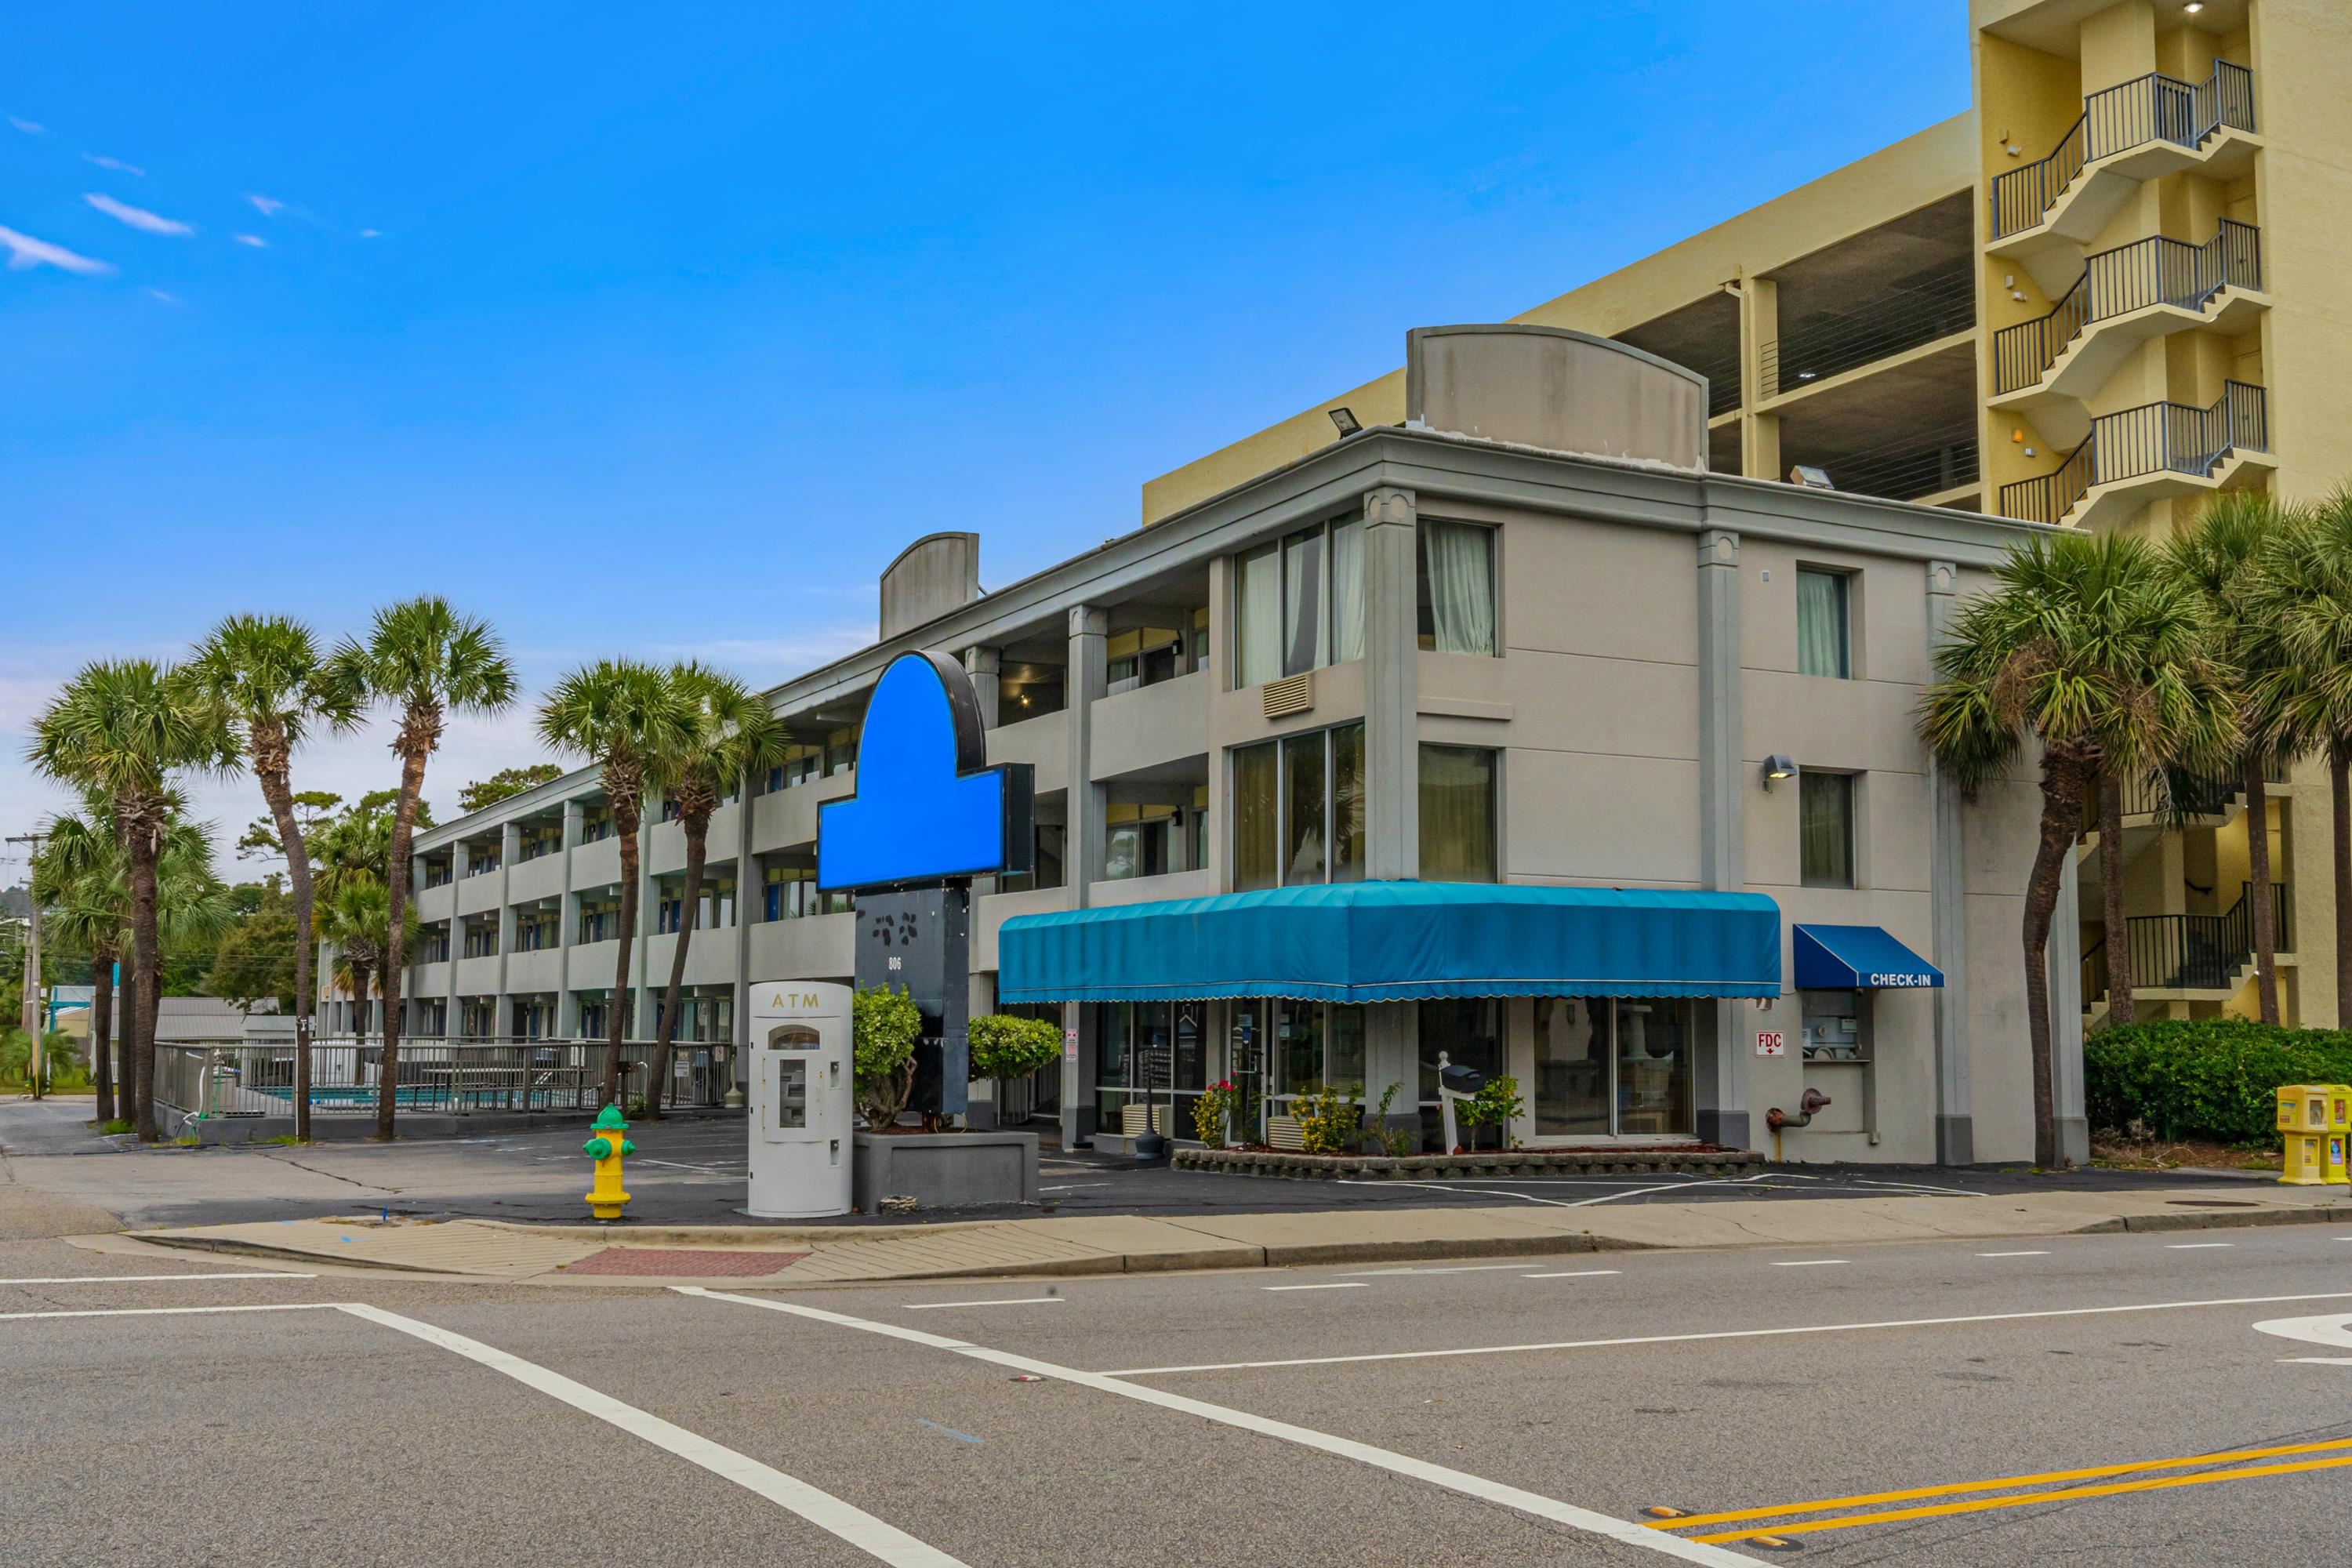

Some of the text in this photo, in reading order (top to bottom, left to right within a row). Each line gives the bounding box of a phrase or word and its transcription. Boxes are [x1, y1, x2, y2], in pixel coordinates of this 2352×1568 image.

[888, 956, 902, 971] 806
[1870, 973, 1931, 986] CHECK-IN
[771, 993, 819, 1008] ATM
[1759, 1033, 1781, 1047] FDC
